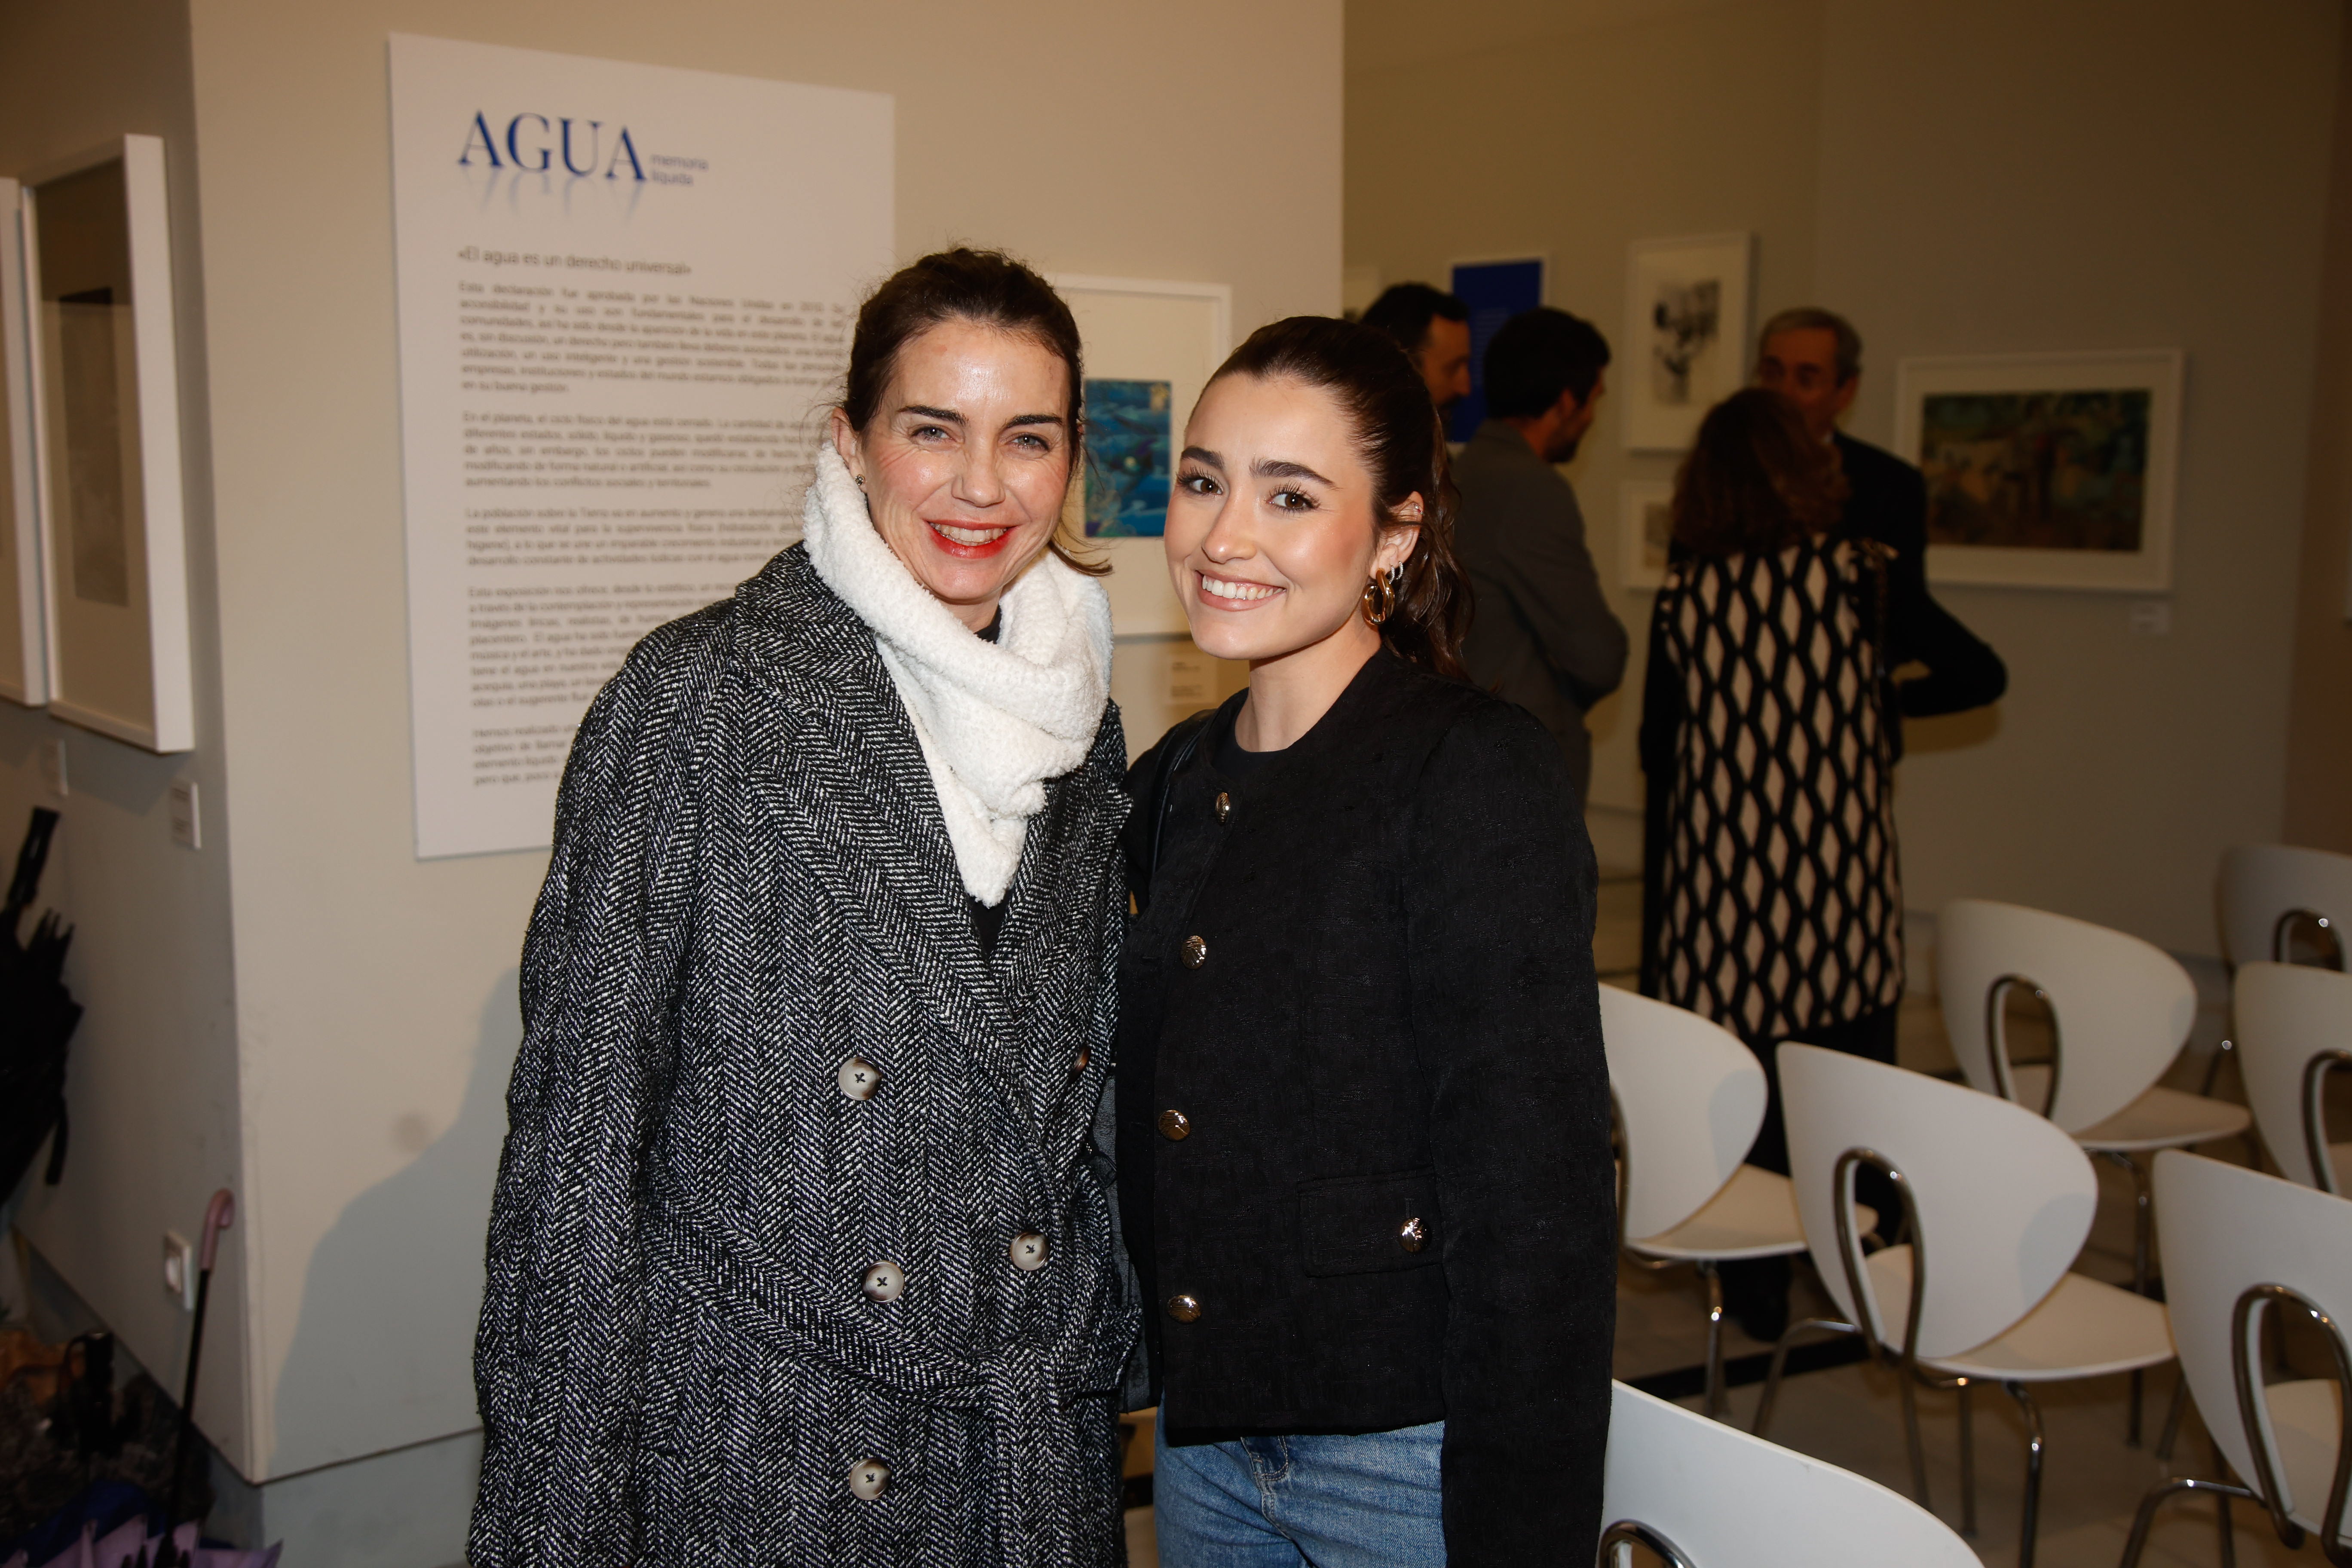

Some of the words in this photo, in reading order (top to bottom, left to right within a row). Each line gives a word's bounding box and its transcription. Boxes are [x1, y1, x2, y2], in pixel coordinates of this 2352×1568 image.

[458, 109, 646, 181] AGUA
[650, 153, 708, 171] memoria
[483, 251, 520, 266] agua
[523, 254, 540, 267] es
[543, 256, 564, 269] un
[565, 255, 622, 271] derecho
